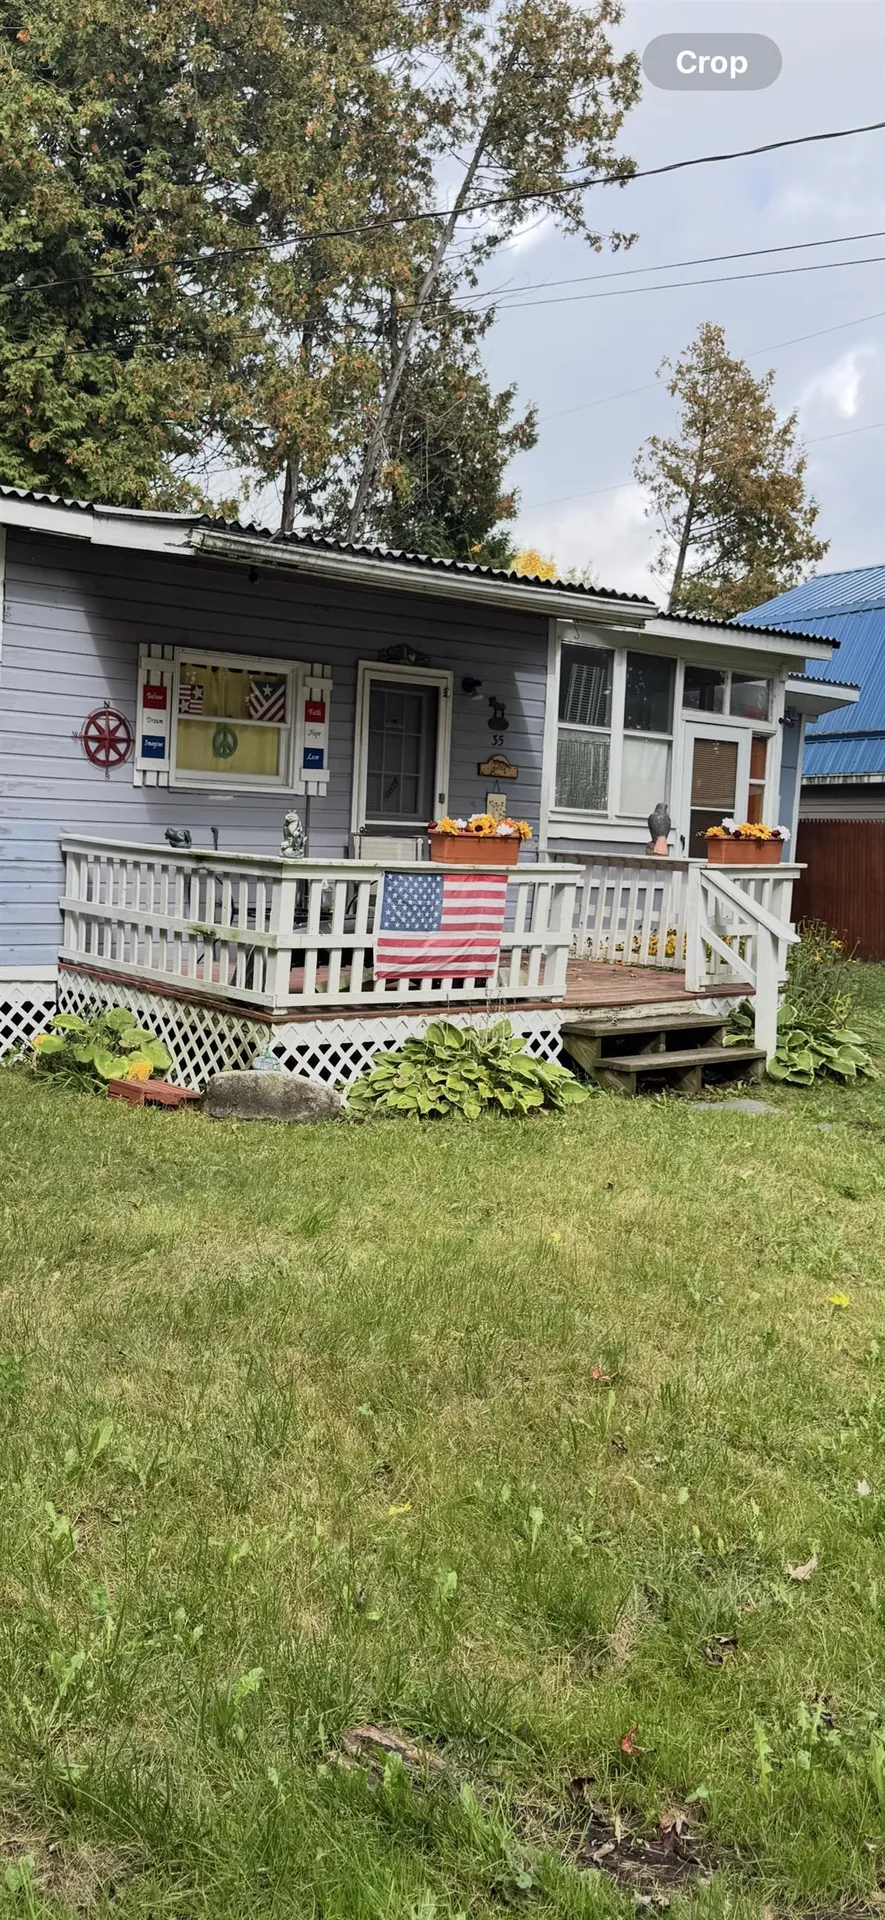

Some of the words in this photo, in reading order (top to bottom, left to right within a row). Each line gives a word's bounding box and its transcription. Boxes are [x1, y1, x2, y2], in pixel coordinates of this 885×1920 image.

[103, 700, 111, 708] N
[307, 708, 322, 716] Faith
[146, 716, 164, 725] Dream
[307, 728, 322, 740] Hope
[144, 739, 163, 750] Imagine
[491, 734, 504, 746] 35
[306, 753, 320, 761] Love
